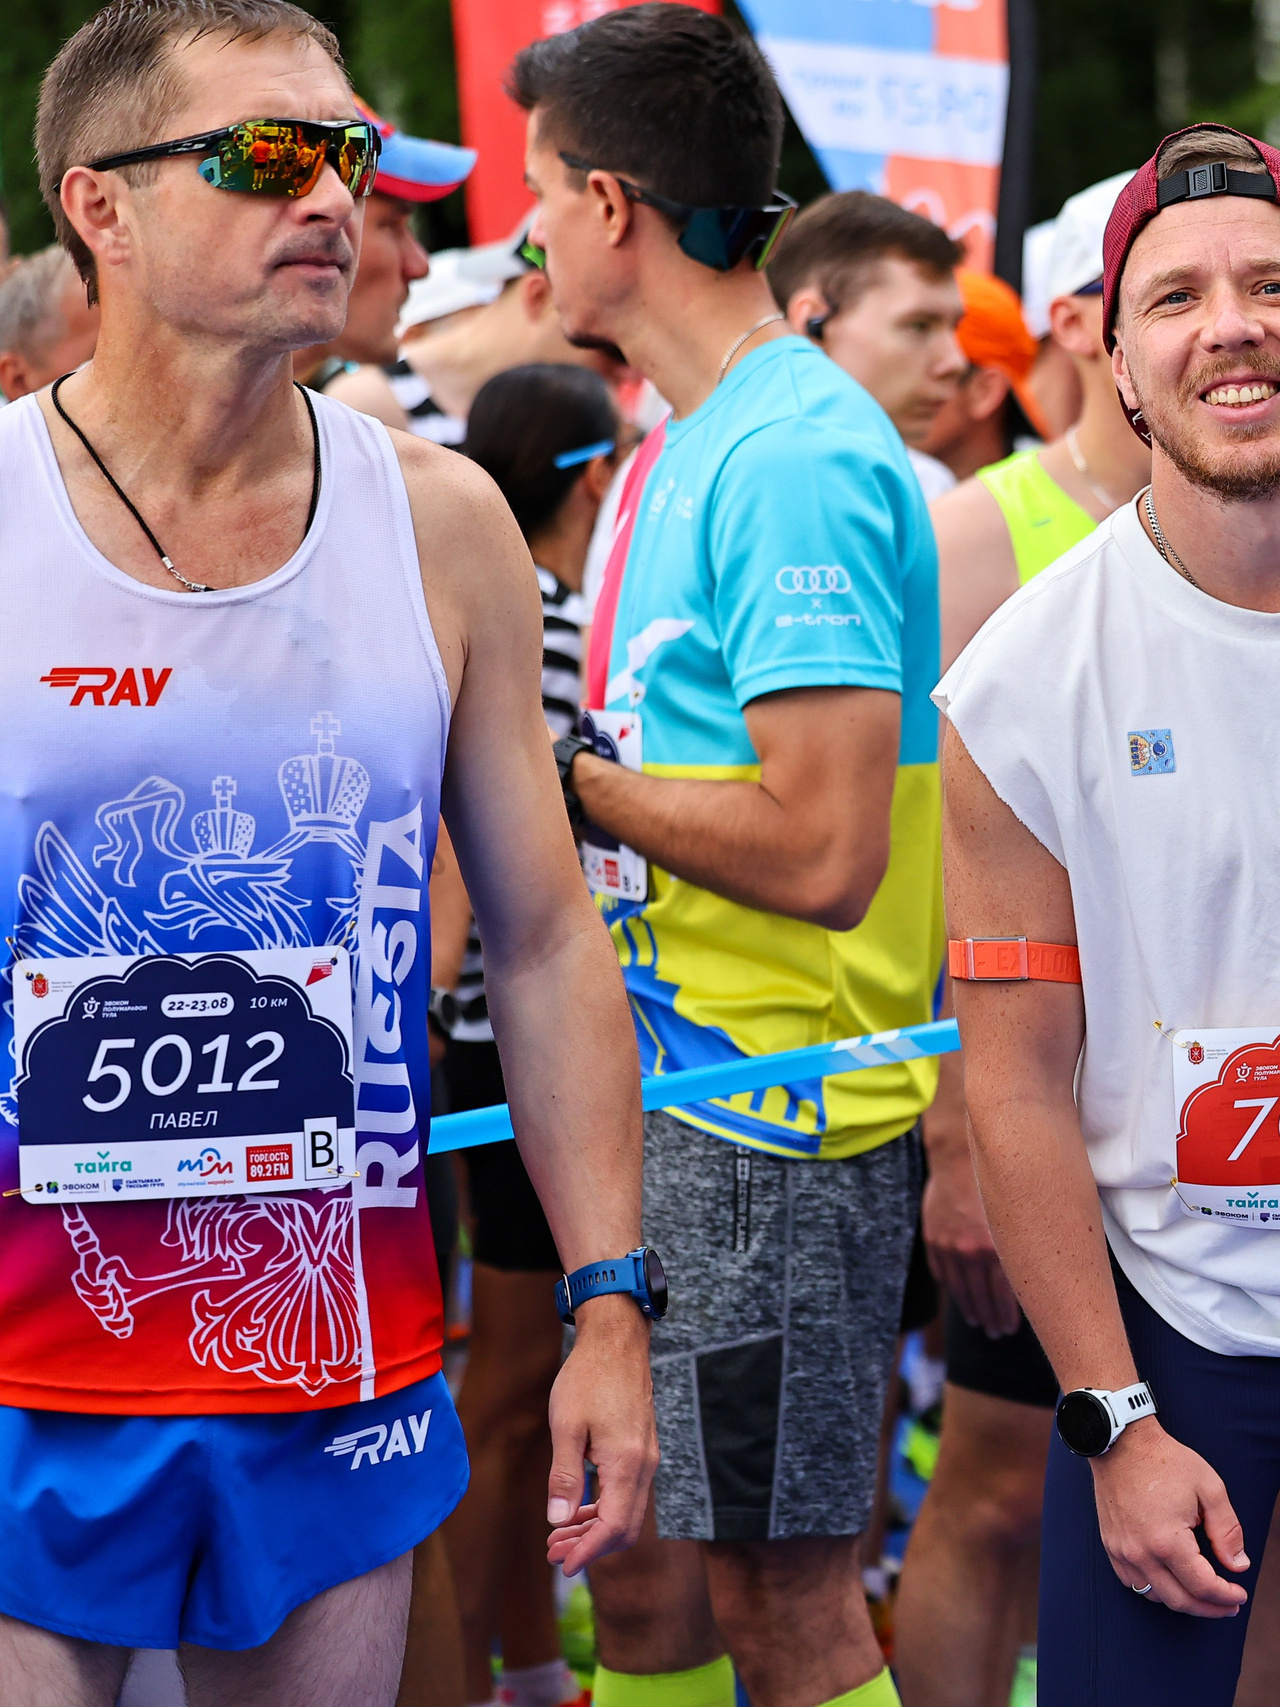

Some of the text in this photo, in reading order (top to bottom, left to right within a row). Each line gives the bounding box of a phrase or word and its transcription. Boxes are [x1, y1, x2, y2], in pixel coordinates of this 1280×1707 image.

[39, 667, 173, 706] RAY
[167, 997, 229, 1012] 22-23.08
[249, 996, 268, 1009] 10
[82, 1030, 286, 1113] 5012
[149, 1109, 219, 1131] ПАВЕЛ
[74, 1151, 132, 1174] тайга
[250, 1162, 290, 1178] 89.2 FM
[62, 1182, 100, 1191] ЭВОКОМ
[1225, 1191, 1279, 1209] тайга
[1214, 1210, 1249, 1219] ЭВОКОМ
[323, 1408, 433, 1471] RAY
